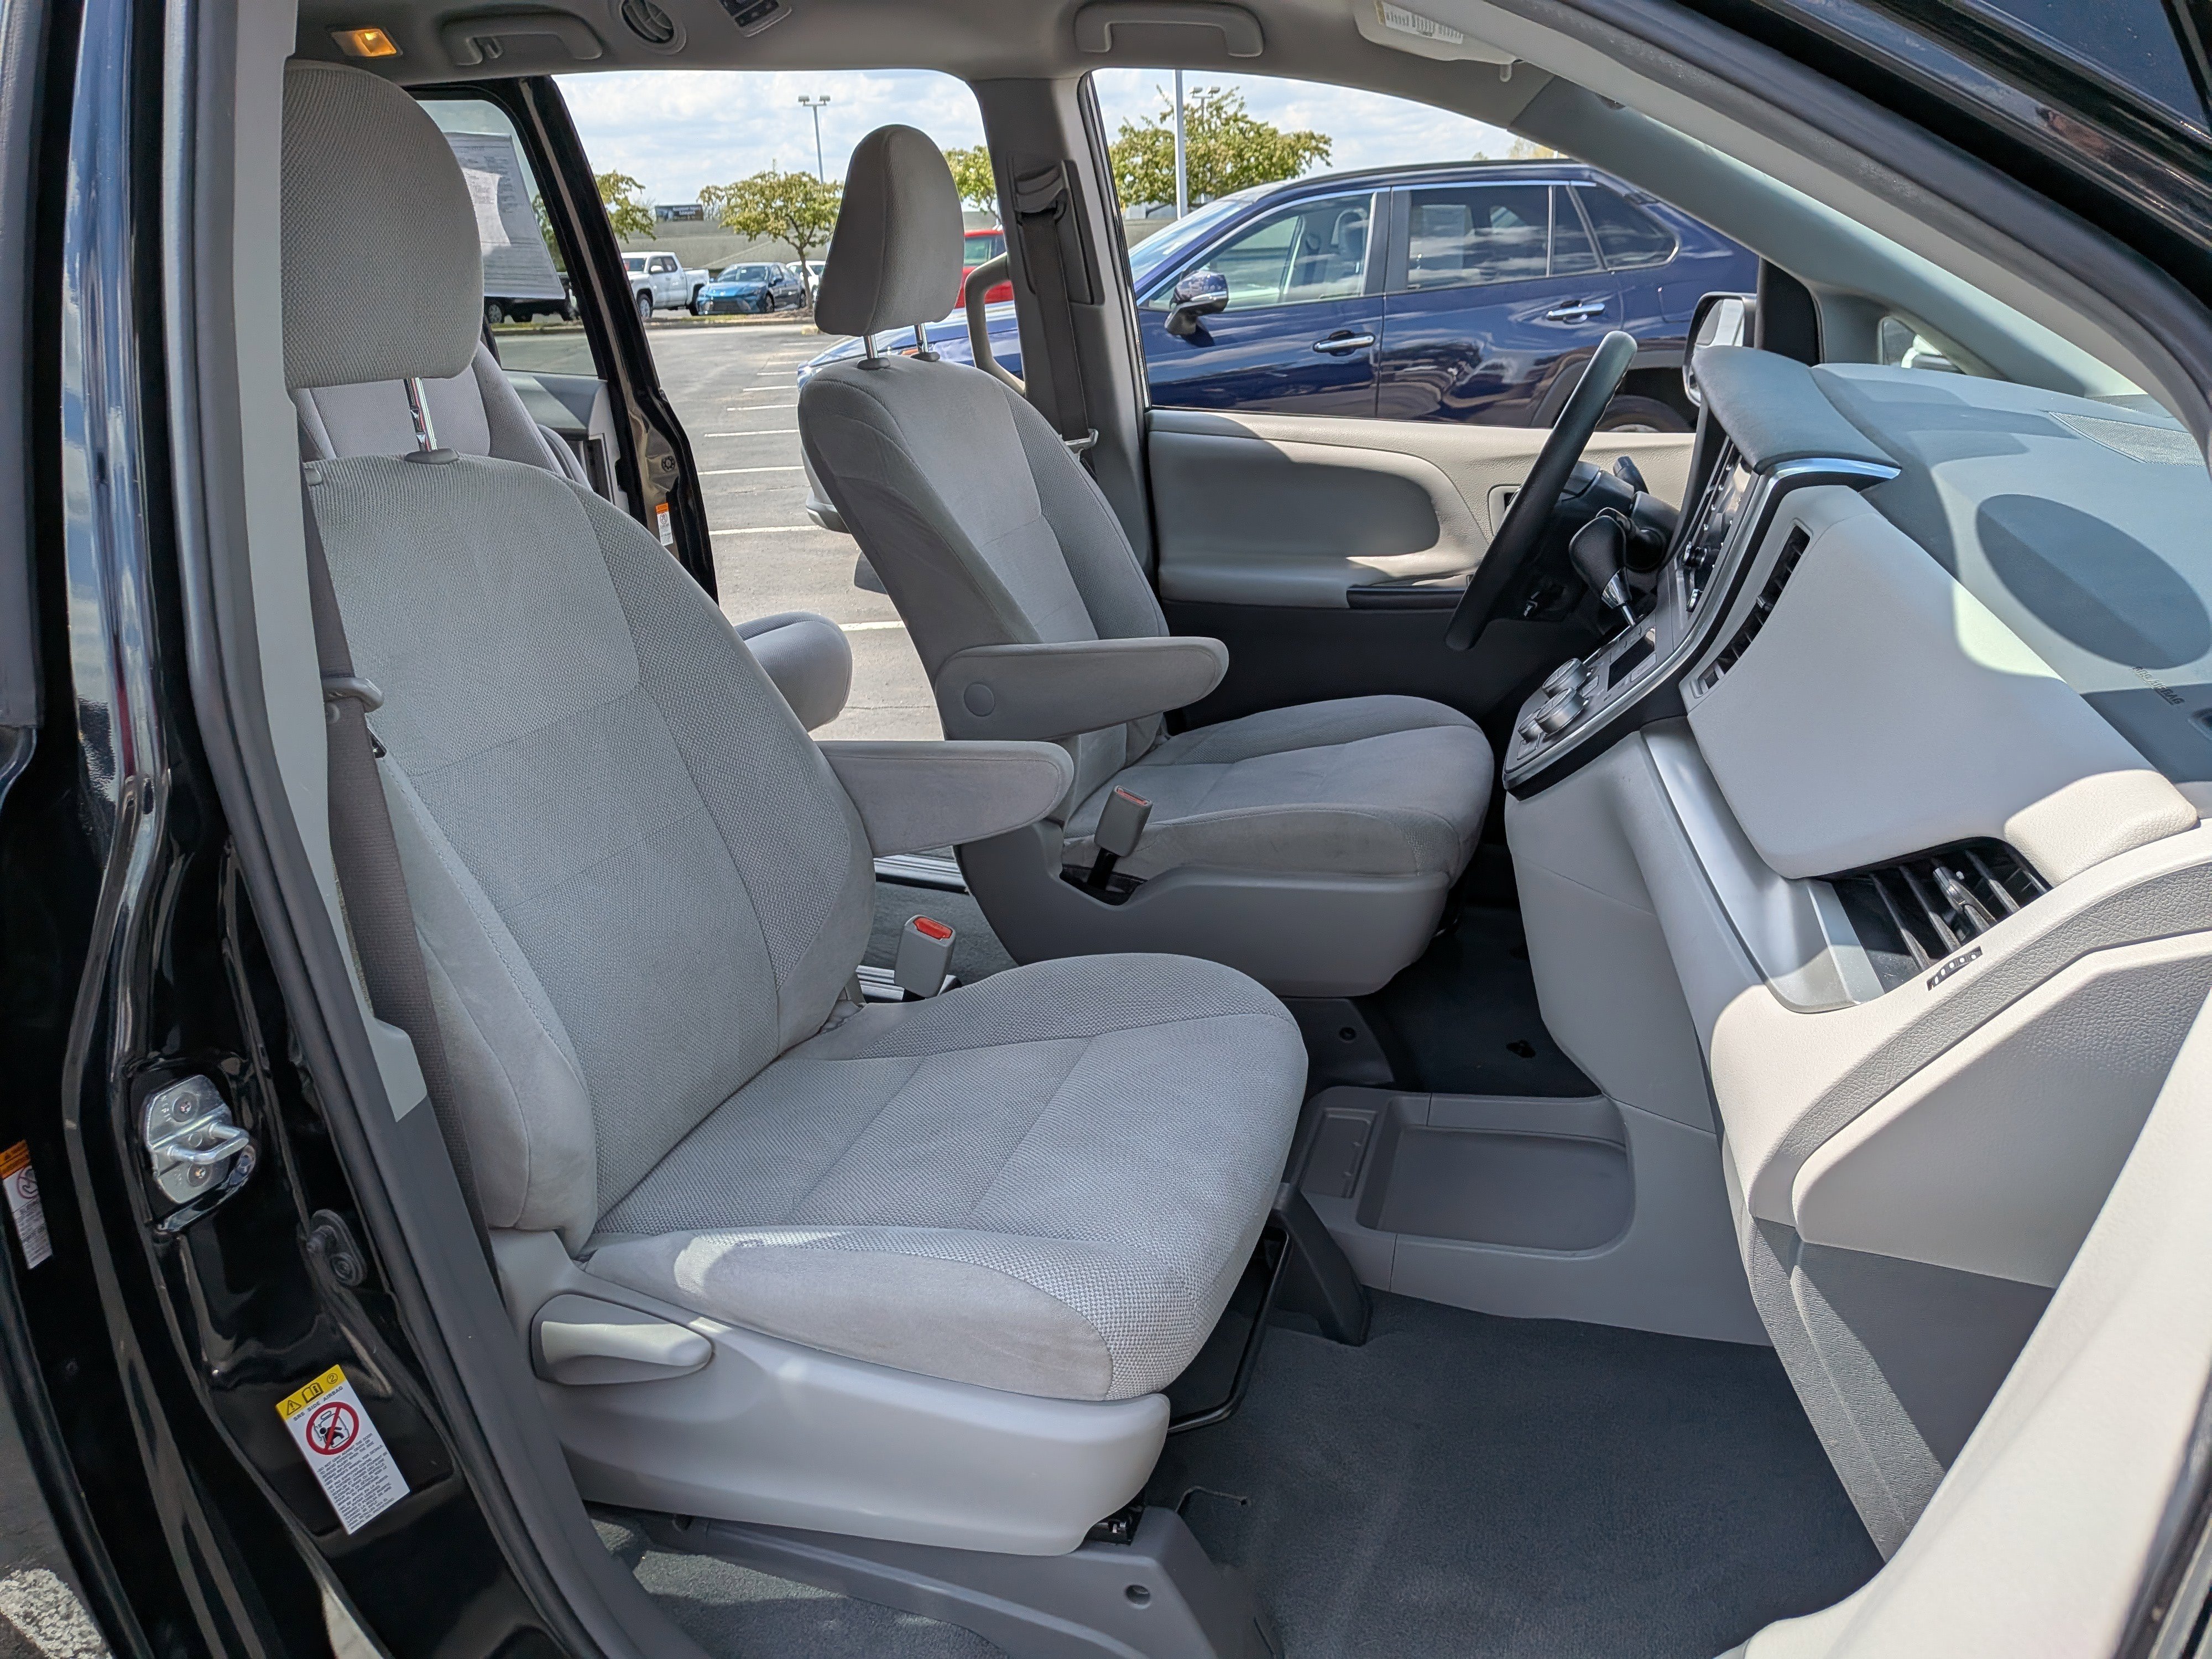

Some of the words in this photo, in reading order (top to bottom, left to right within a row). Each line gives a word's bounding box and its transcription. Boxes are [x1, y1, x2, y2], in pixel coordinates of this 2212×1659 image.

[2146, 679, 2185, 705] AIRBAG
[293, 1411, 305, 1421] SRS
[307, 1400, 321, 1412] SIDE
[322, 1385, 343, 1401] AIRBAG
[362, 1432, 373, 1441] DOOR
